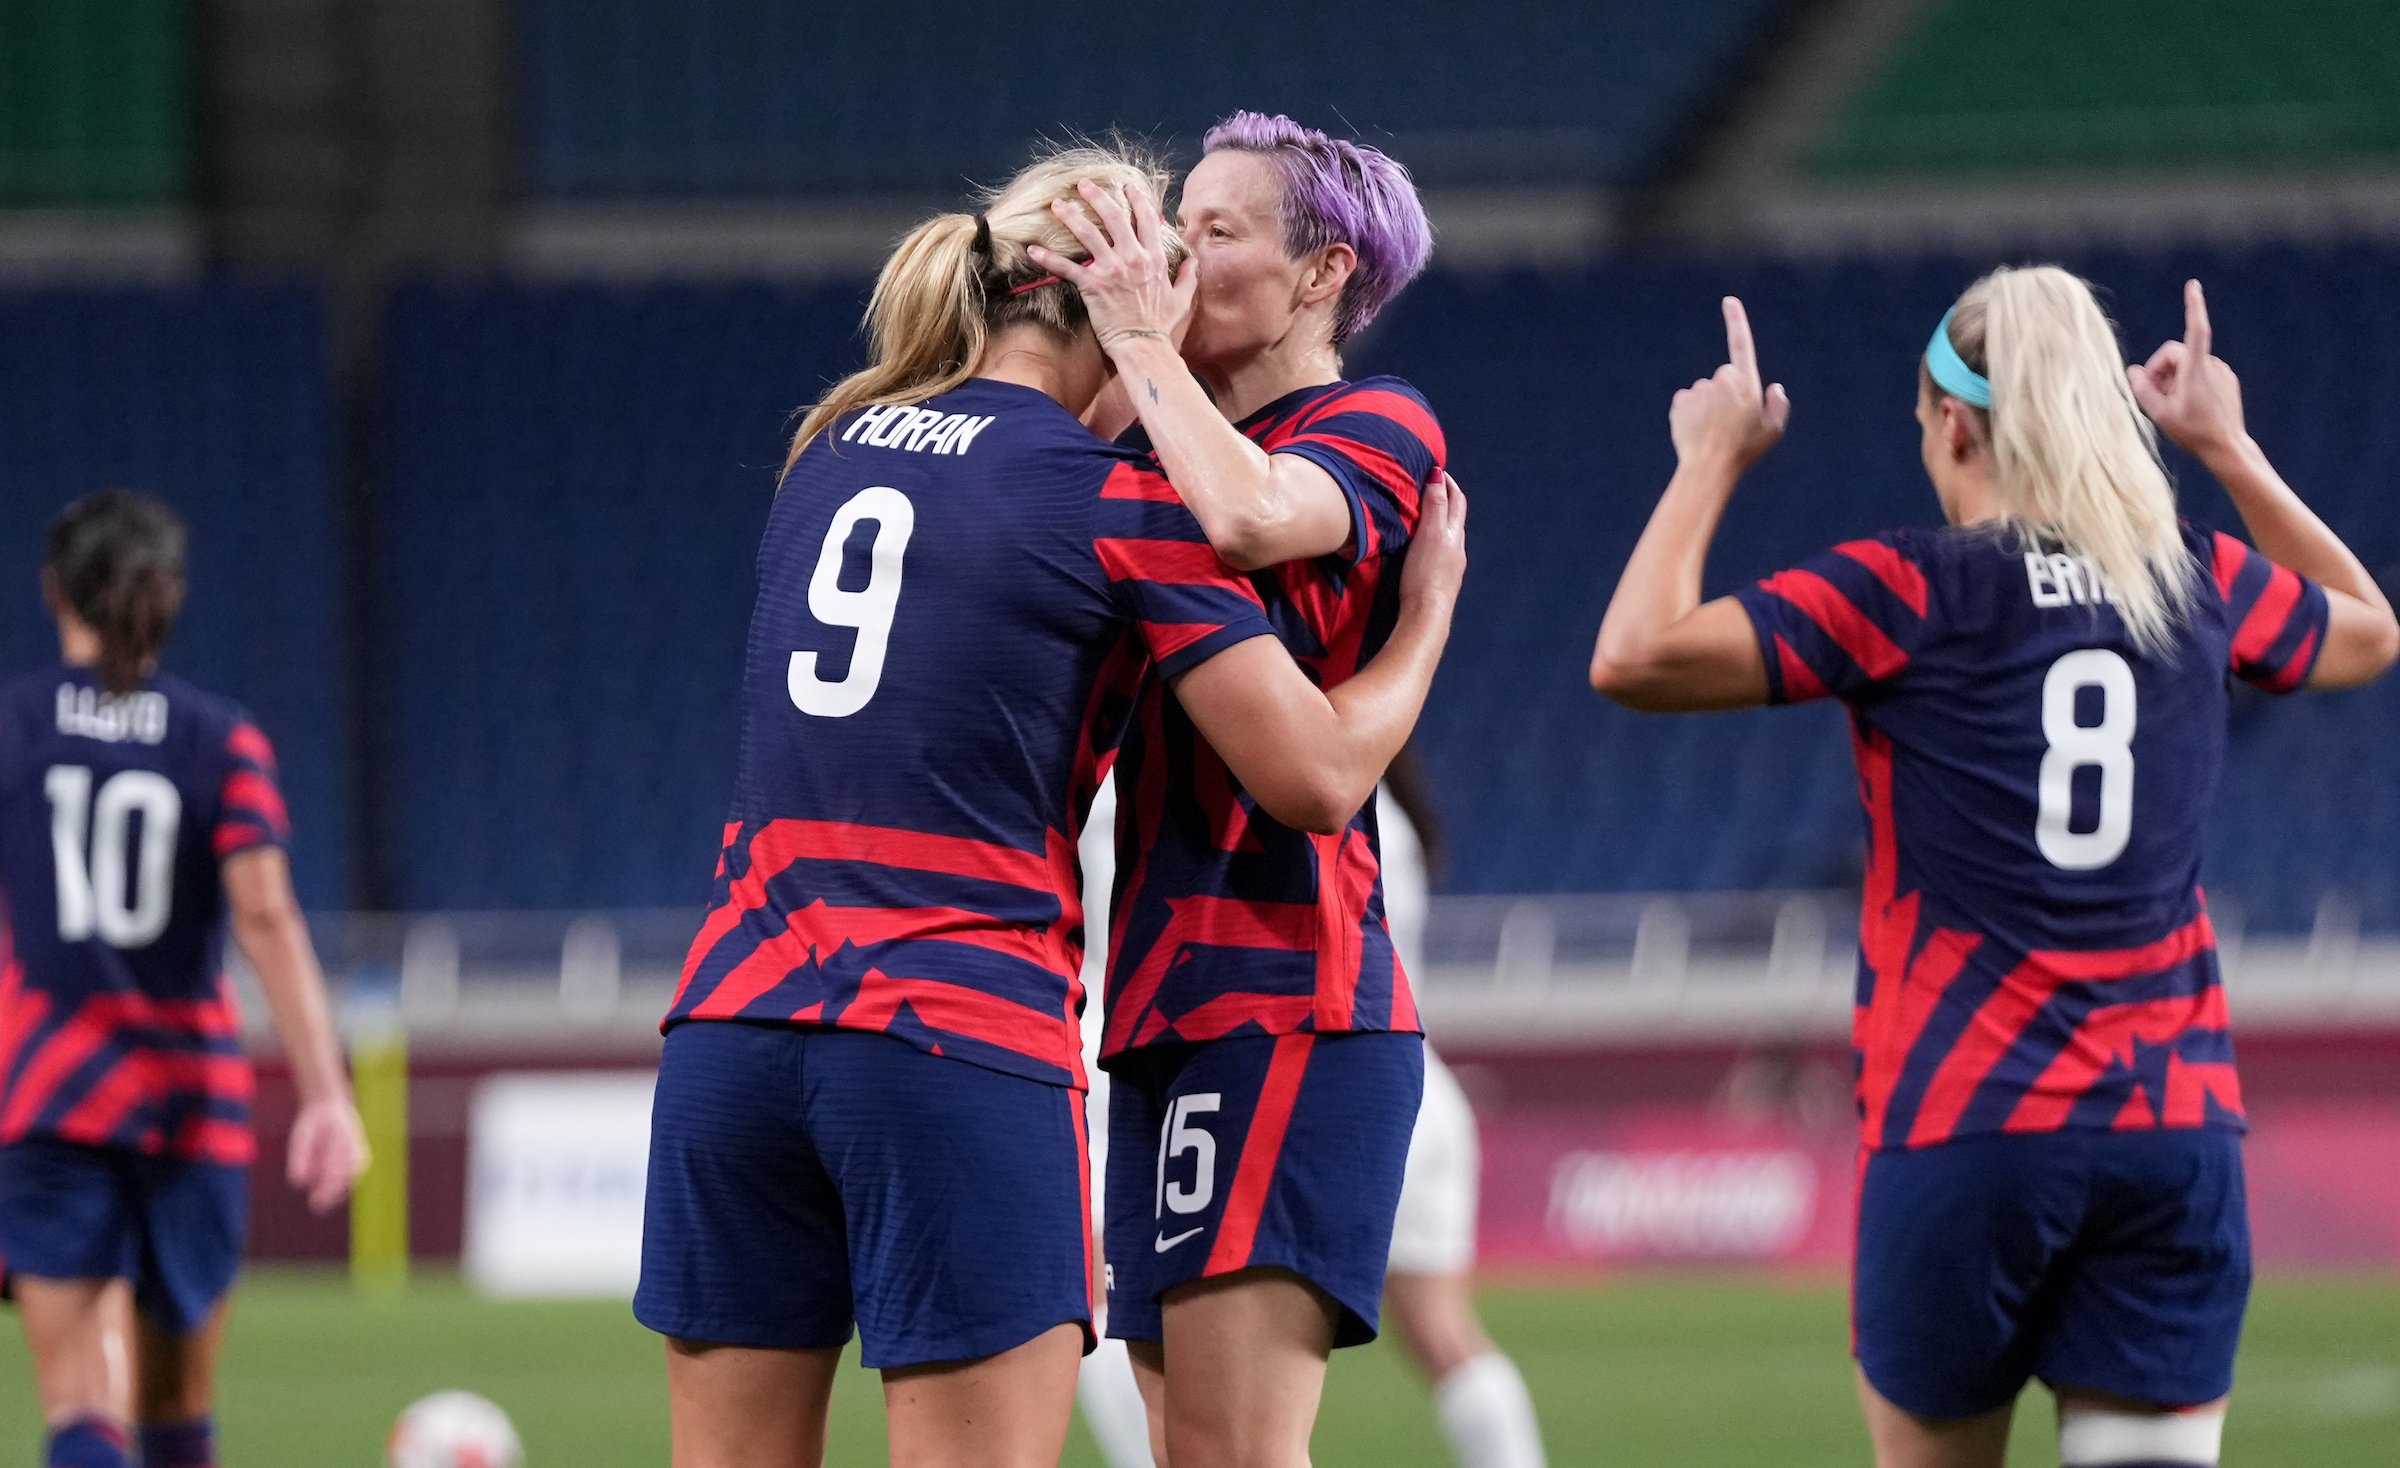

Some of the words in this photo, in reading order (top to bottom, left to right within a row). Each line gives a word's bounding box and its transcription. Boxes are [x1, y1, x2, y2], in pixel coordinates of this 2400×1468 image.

[841, 404, 996, 455] HORAN
[787, 486, 914, 718] 9
[2023, 551, 2117, 608] ERT
[2035, 648, 2137, 872] 8
[45, 764, 181, 948] 10
